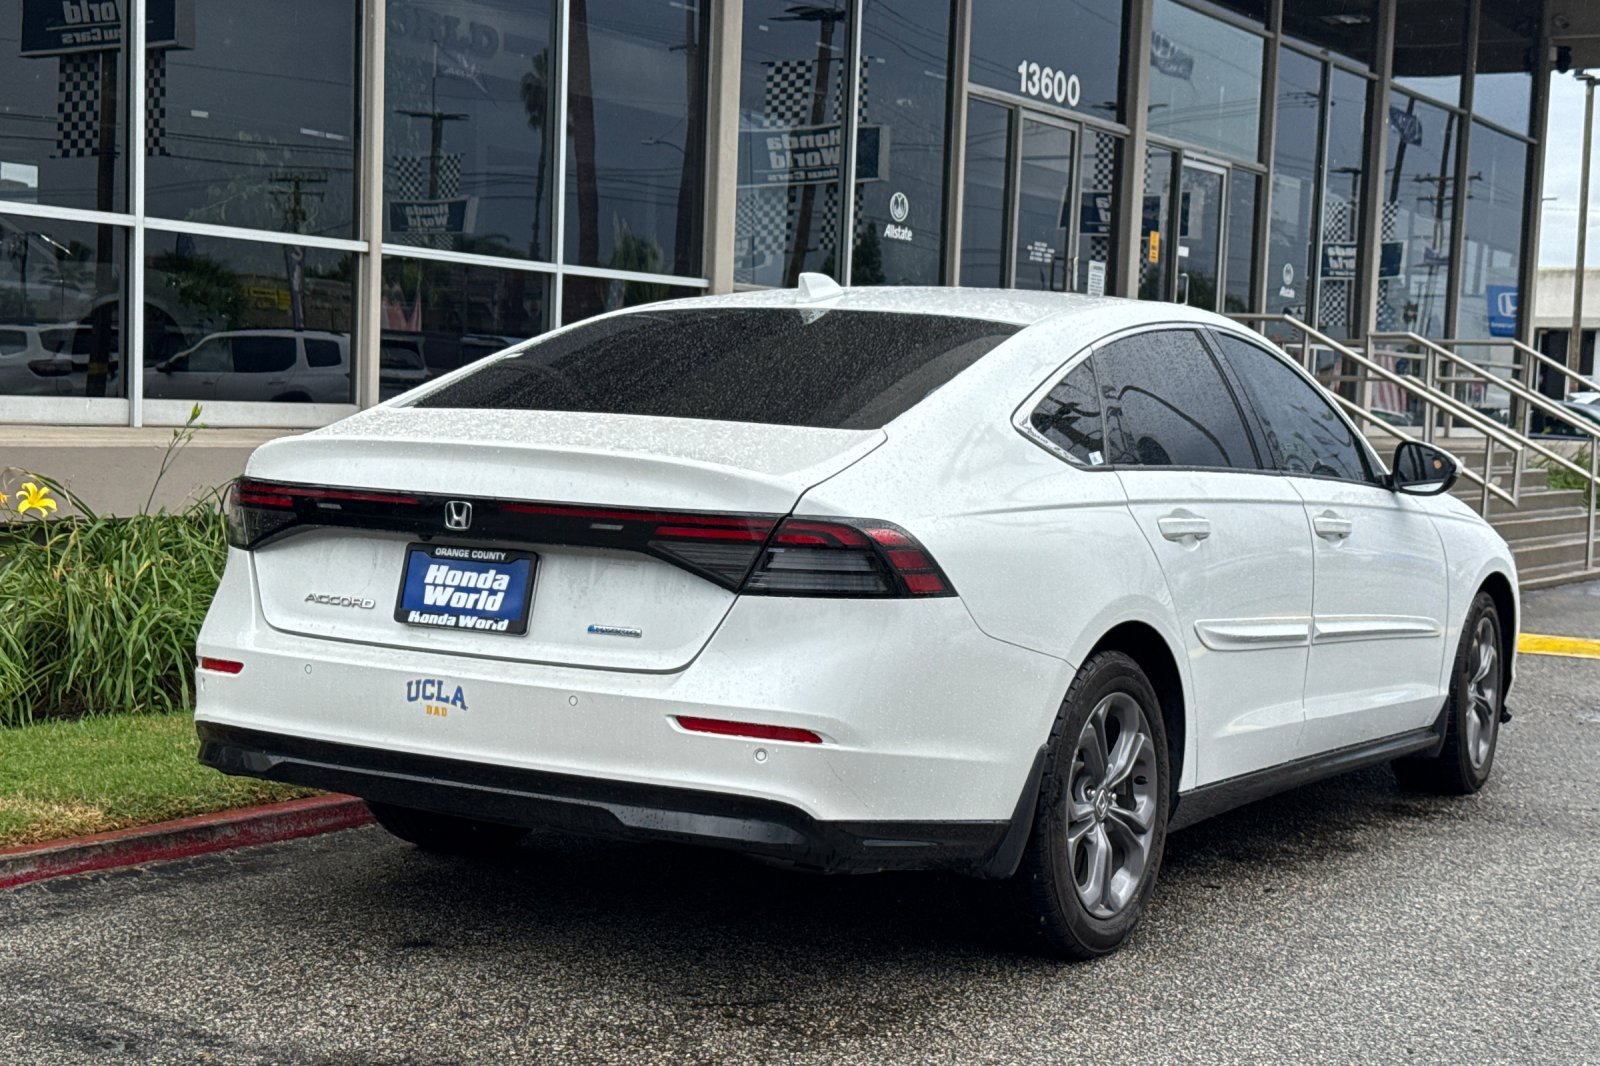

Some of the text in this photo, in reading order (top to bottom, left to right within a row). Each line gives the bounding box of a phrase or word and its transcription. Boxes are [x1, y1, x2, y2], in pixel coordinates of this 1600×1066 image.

[1018, 60, 1080, 107] 13600
[884, 224, 913, 241] Allstate
[435, 547, 507, 561] ORANGE COUNTY
[424, 564, 510, 591] Honda
[304, 592, 376, 610] ACCORD
[423, 585, 505, 612] World
[407, 610, 509, 631] Honda World
[406, 679, 468, 711] UCLA
[426, 704, 448, 717] DAD
